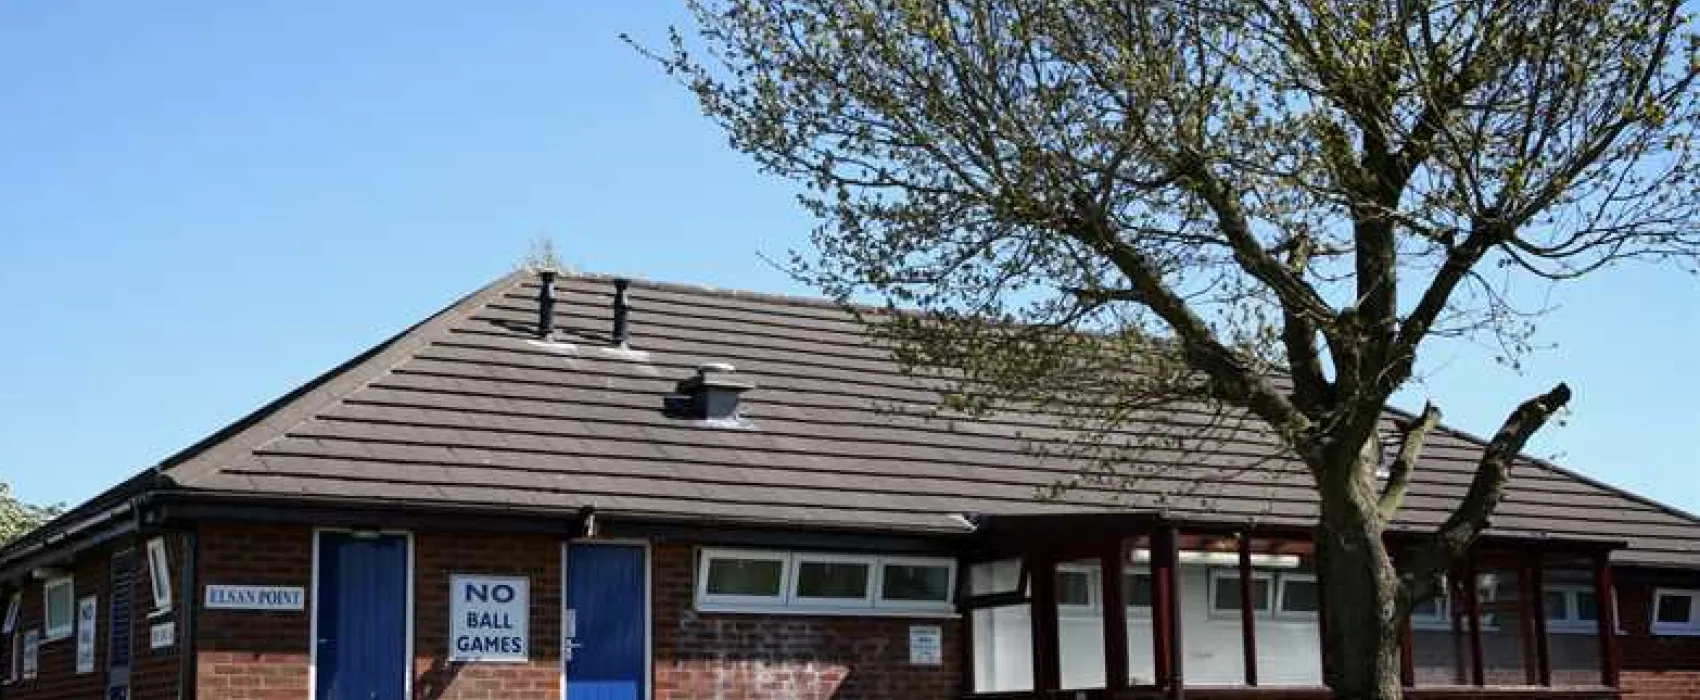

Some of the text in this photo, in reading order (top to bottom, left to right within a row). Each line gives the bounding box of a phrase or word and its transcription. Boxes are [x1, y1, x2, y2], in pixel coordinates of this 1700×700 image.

[258, 590, 300, 604] POINT
[466, 584, 514, 603] NO
[466, 611, 512, 629] BALL
[457, 636, 521, 653] GAMES
